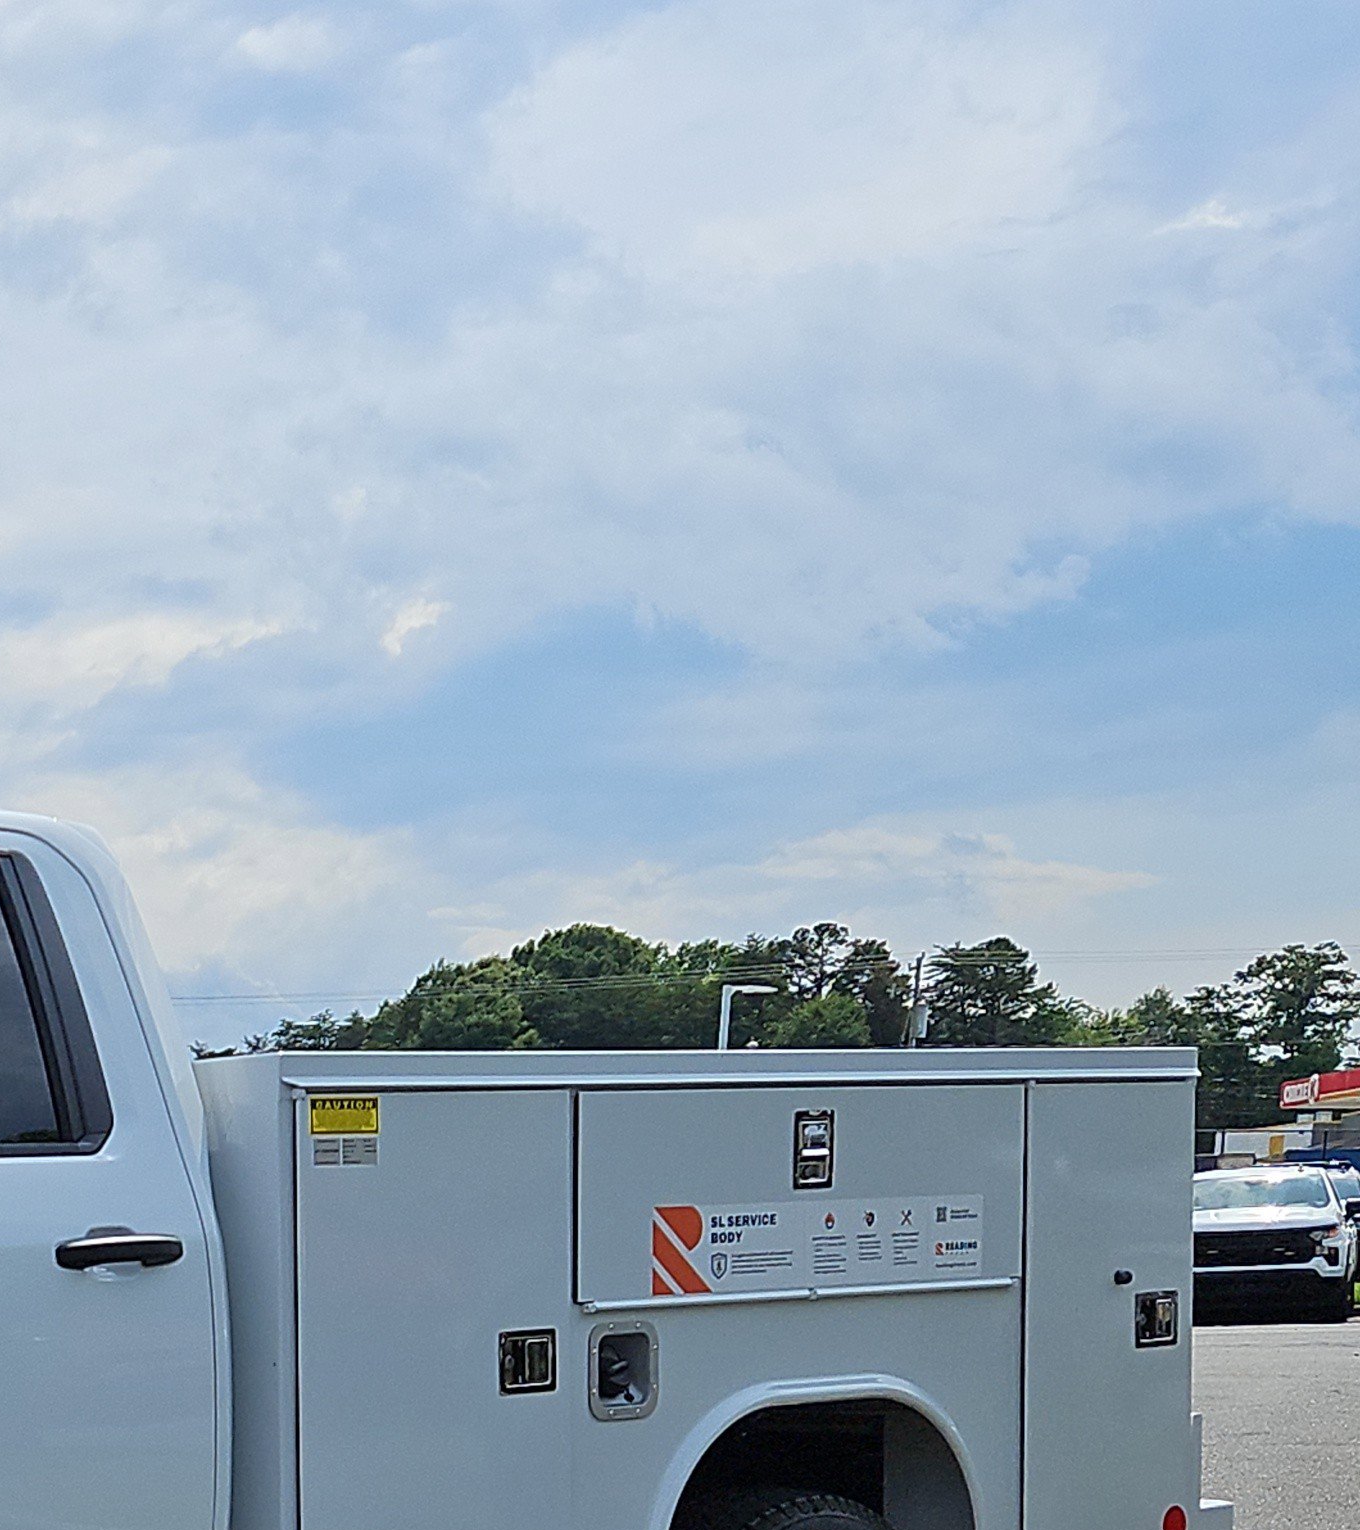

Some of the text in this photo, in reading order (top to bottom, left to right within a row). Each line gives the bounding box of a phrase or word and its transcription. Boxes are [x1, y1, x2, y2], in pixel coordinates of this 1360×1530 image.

[315, 1100, 373, 1110] CAUTION
[710, 1213, 777, 1228] SL SERVICE
[710, 1231, 743, 1244] BODY
